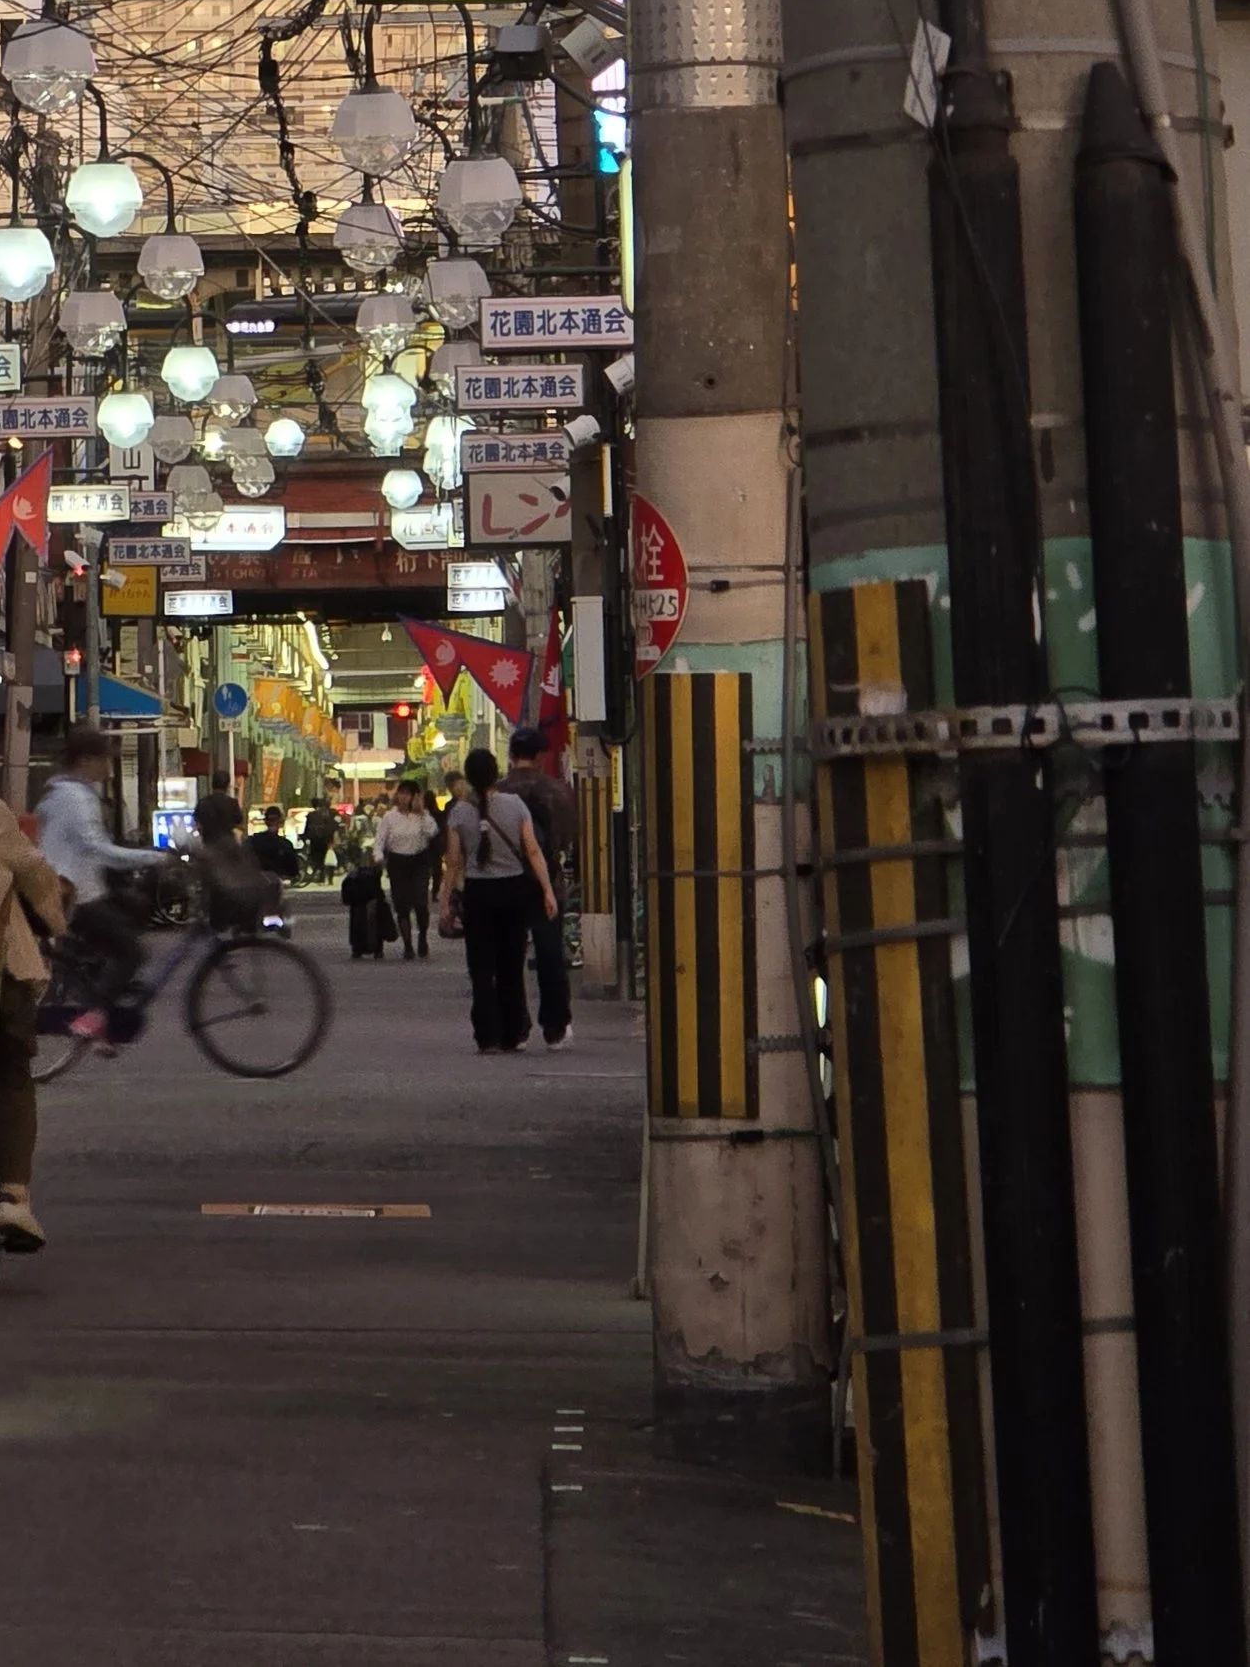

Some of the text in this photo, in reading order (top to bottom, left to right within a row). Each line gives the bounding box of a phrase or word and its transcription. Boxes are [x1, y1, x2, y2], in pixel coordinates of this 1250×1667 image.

[489, 307, 626, 335] 花園北本通会
[464, 375, 578, 400] 花園北本通会
[467, 440, 566, 464] 花園北本通会
[51, 492, 124, 513] 園北本通会
[130, 498, 169, 517] 本通会
[481, 493, 571, 536] レン
[112, 544, 187, 560] 花園北本通会
